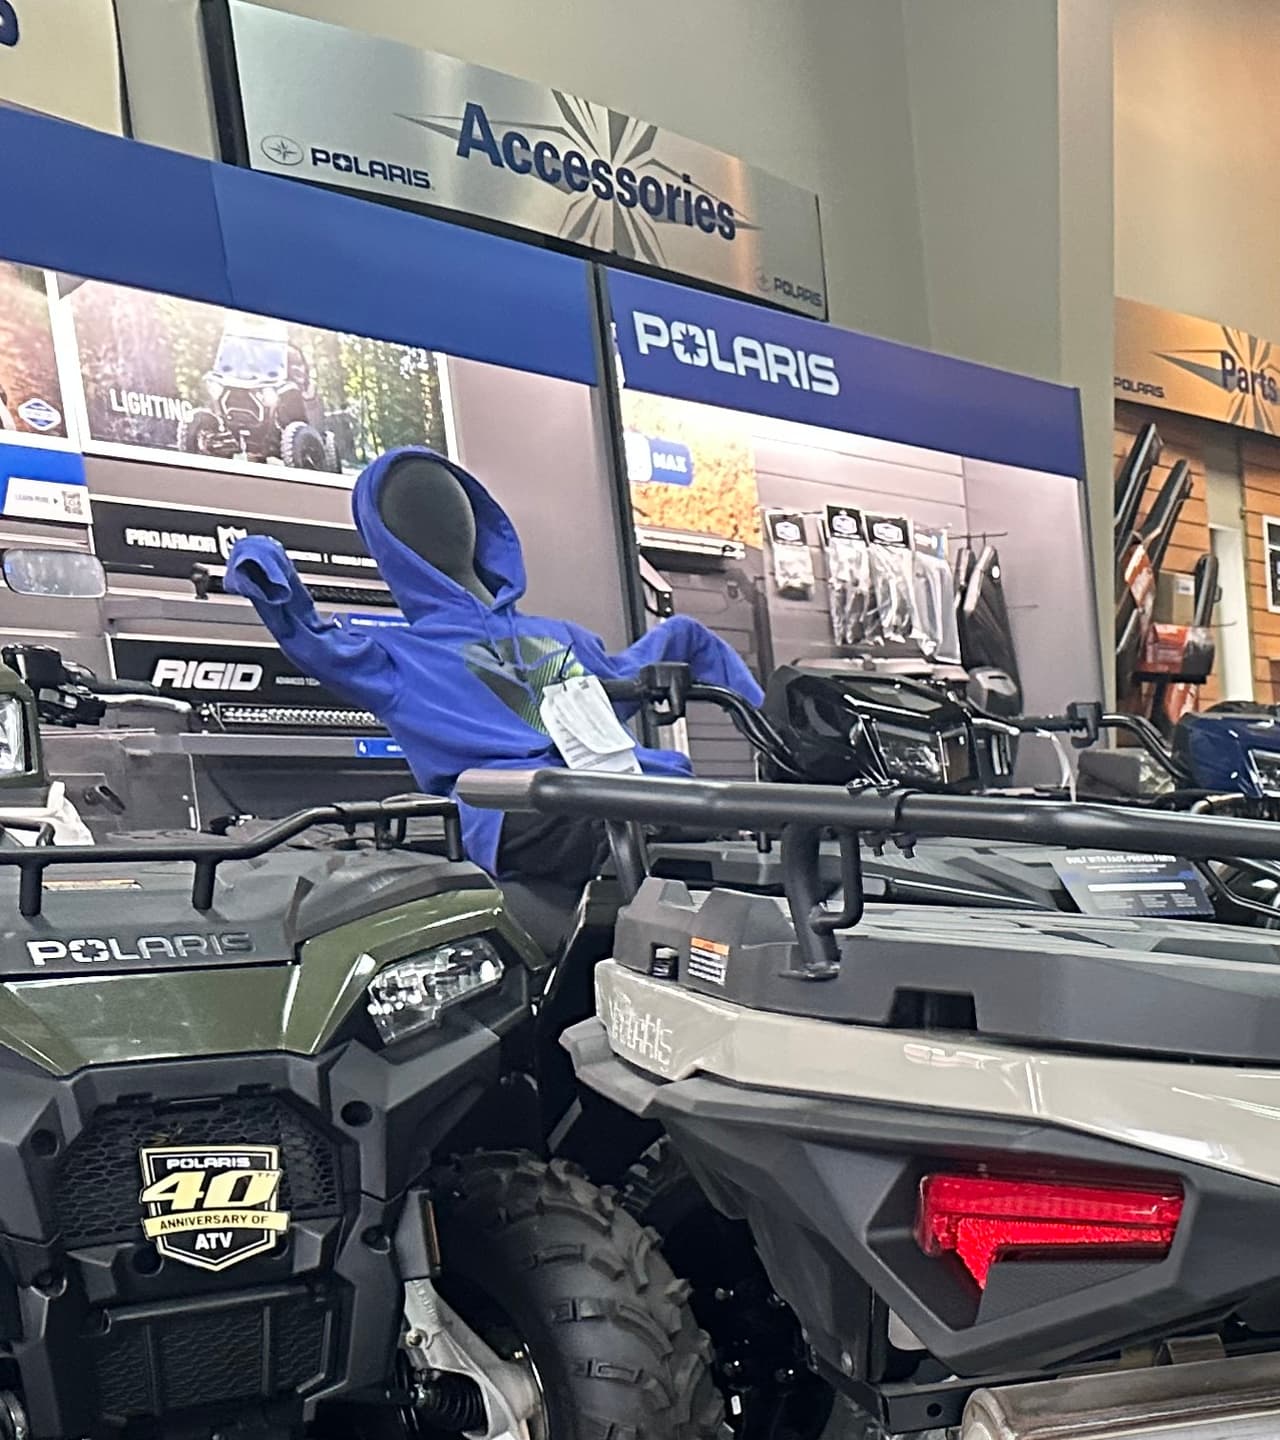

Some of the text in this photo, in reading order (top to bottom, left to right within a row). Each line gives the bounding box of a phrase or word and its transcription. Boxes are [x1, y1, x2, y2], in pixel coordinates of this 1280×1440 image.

[310, 147, 432, 190] POLARIS
[456, 101, 737, 241] Accessories
[773, 276, 823, 307] POLARIS
[632, 310, 840, 396] POLARIS
[1113, 376, 1165, 398] POLARIS
[1220, 350, 1279, 402] Parts
[109, 388, 195, 423] LIGHTING
[152, 659, 263, 691] RIGID
[26, 931, 256, 968] POLARIS
[166, 1156, 251, 1170] POLARIS
[141, 1169, 282, 1211] 40
[160, 1214, 269, 1231] ANNIVERSARY OF
[194, 1231, 234, 1251] ATV
